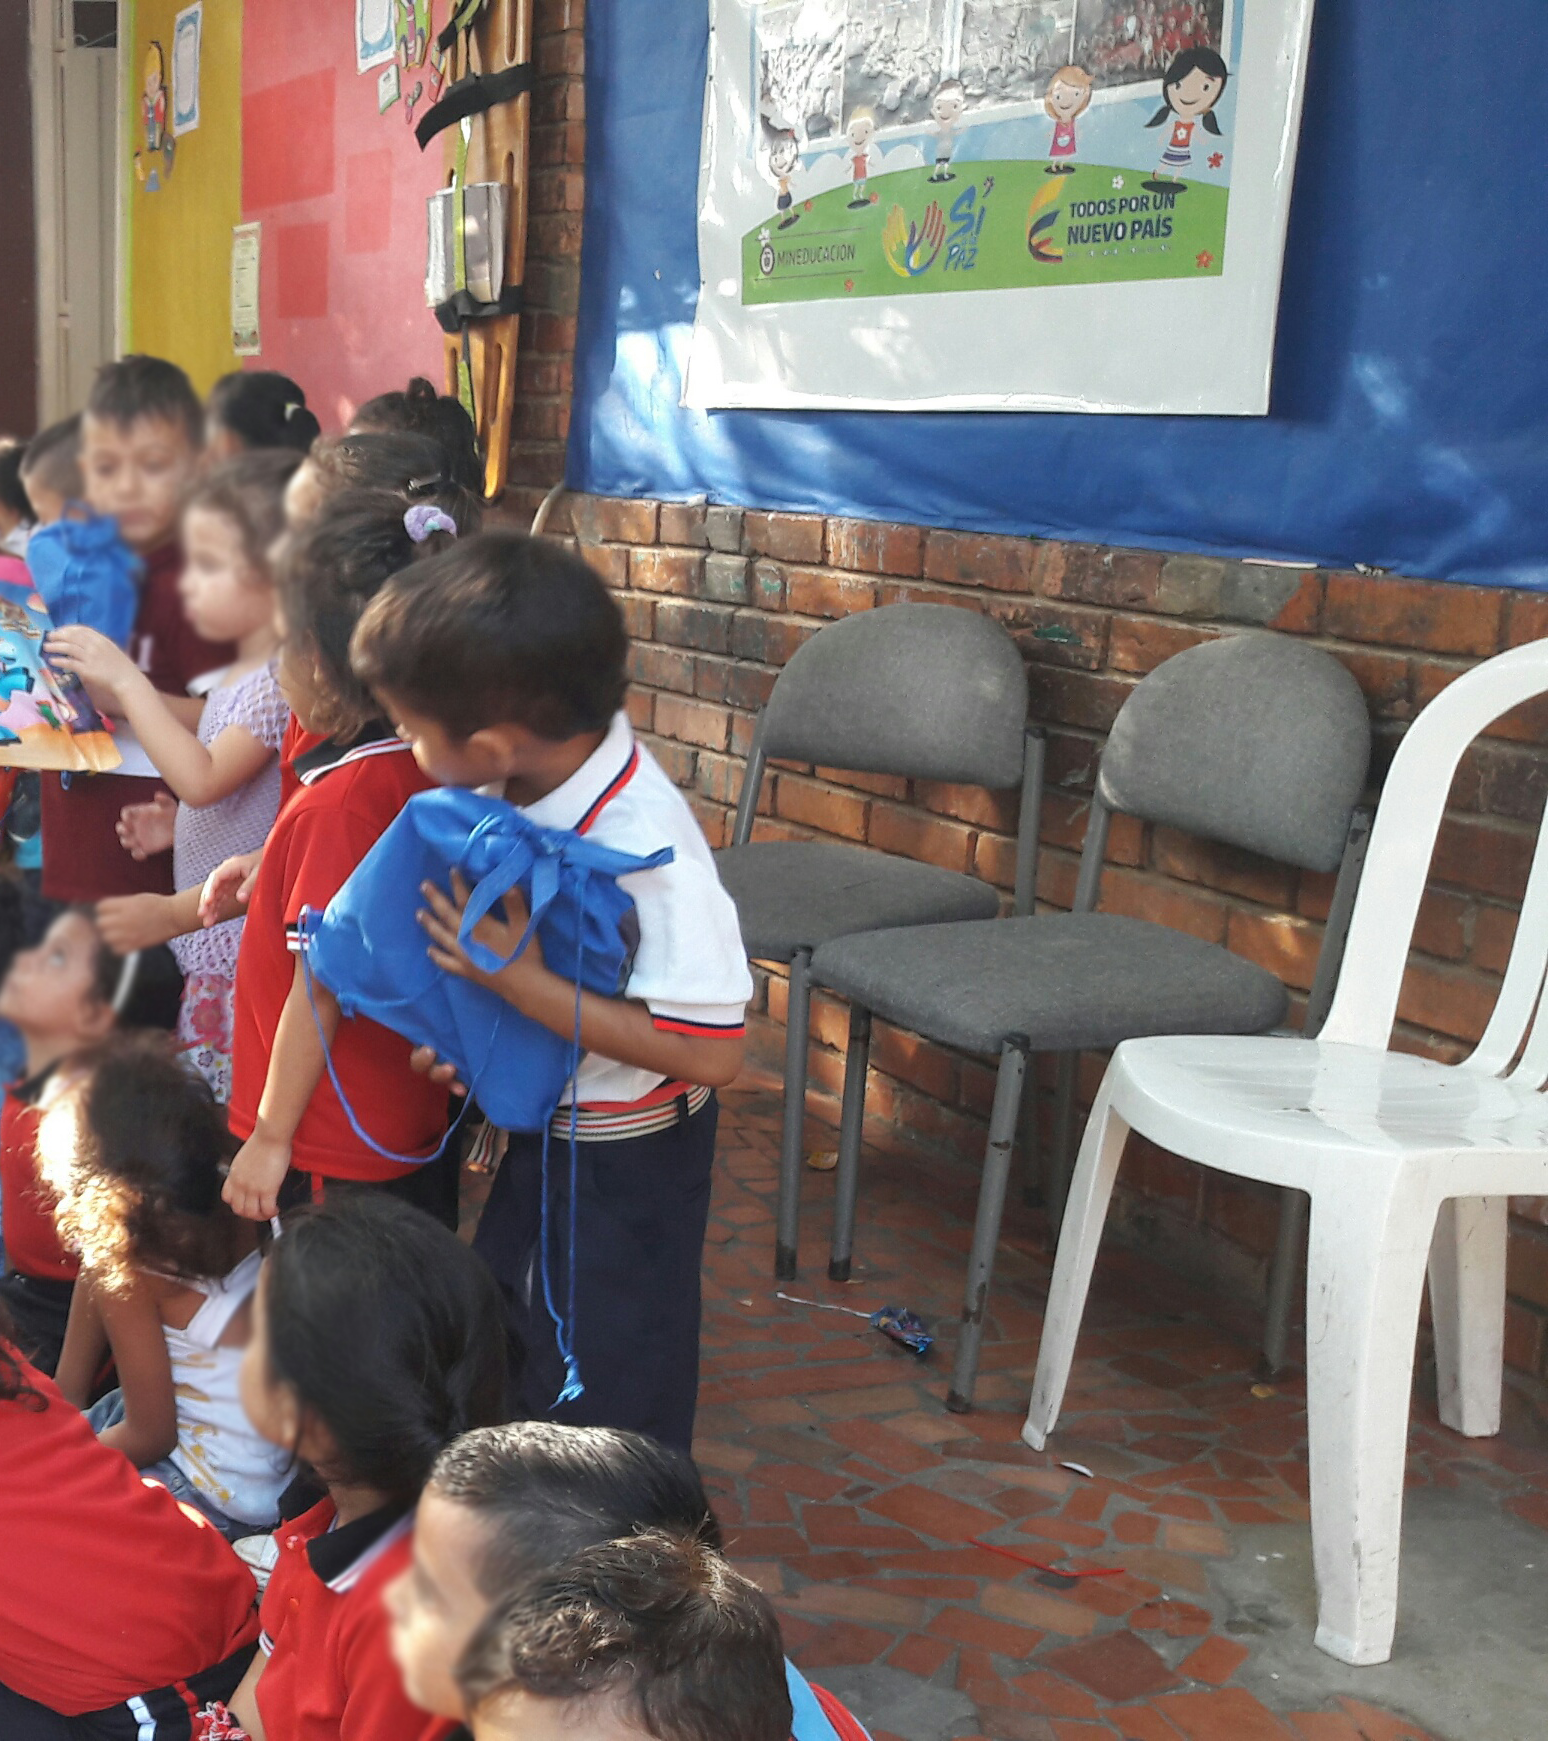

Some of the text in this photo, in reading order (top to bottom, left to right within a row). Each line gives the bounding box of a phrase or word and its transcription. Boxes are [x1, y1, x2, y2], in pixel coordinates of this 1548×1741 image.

[1070, 192, 1175, 218] TODOS POR UN
[1067, 214, 1173, 245] NUEVO PAÍS
[943, 245, 978, 271] PAZ
